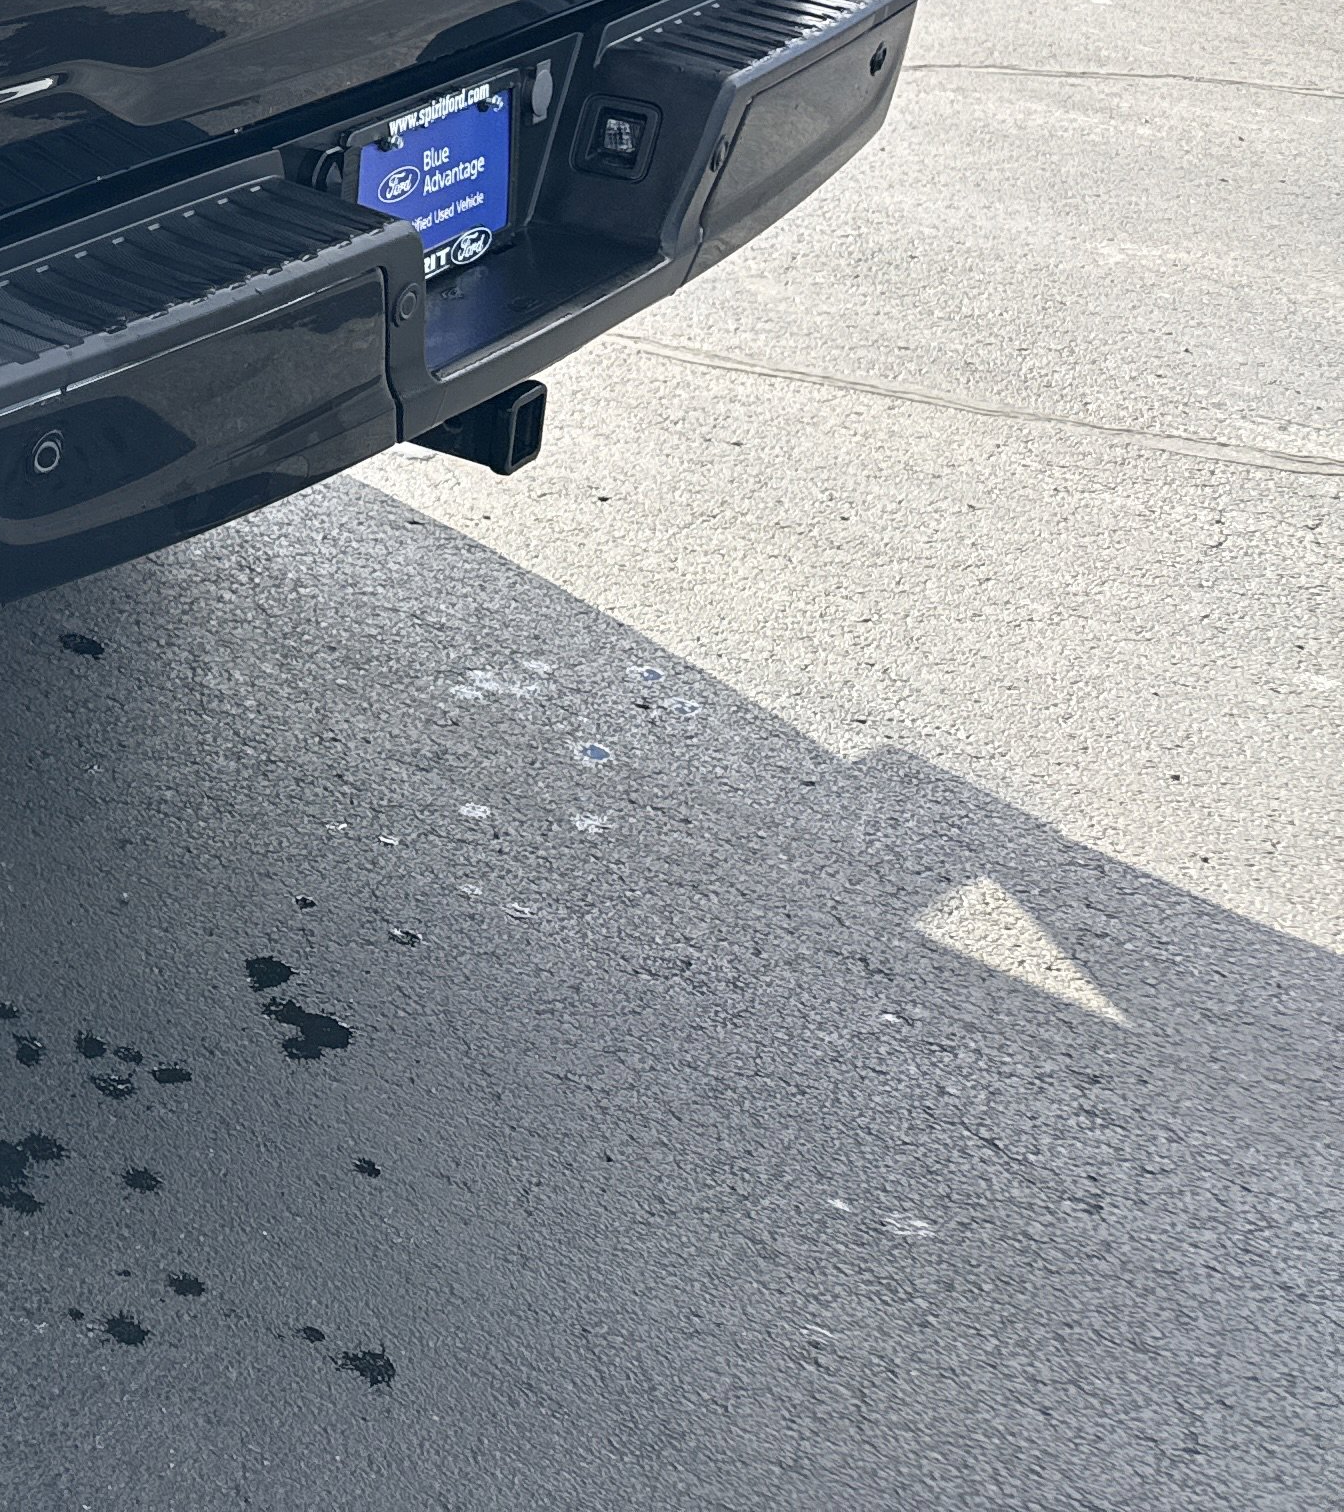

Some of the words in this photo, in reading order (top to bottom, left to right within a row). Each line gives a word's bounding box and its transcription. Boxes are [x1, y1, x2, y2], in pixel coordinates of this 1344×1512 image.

[389, 84, 490, 136] www.spiritford.com
[423, 147, 450, 171] Blue
[385, 171, 413, 199] Ford
[423, 156, 485, 196] Advantage
[434, 202, 455, 224] Used
[456, 191, 485, 214] Vehicle
[457, 232, 486, 261] Ford
